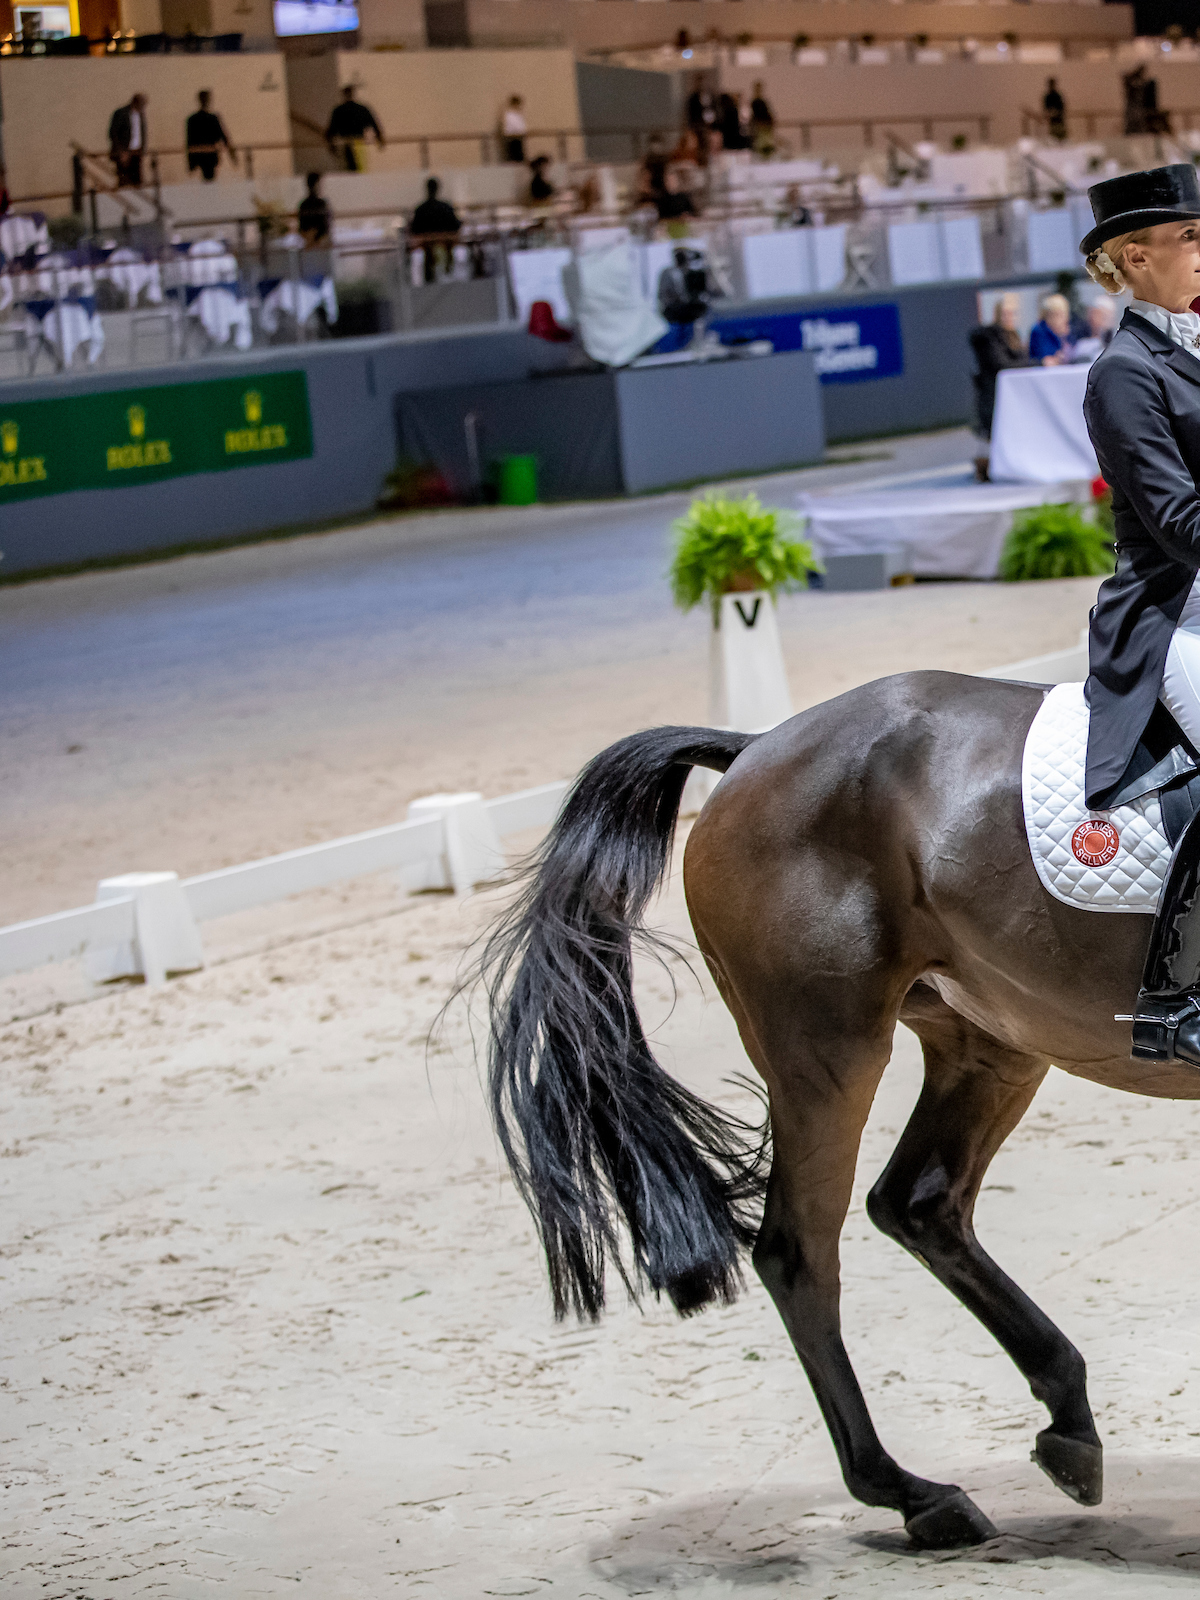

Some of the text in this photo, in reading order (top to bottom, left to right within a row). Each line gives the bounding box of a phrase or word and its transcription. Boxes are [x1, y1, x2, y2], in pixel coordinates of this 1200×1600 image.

[106, 440, 172, 471] ROLEX
[0, 456, 47, 487] OLEX
[734, 597, 762, 628] V
[1075, 846, 1116, 866] SELLIER
